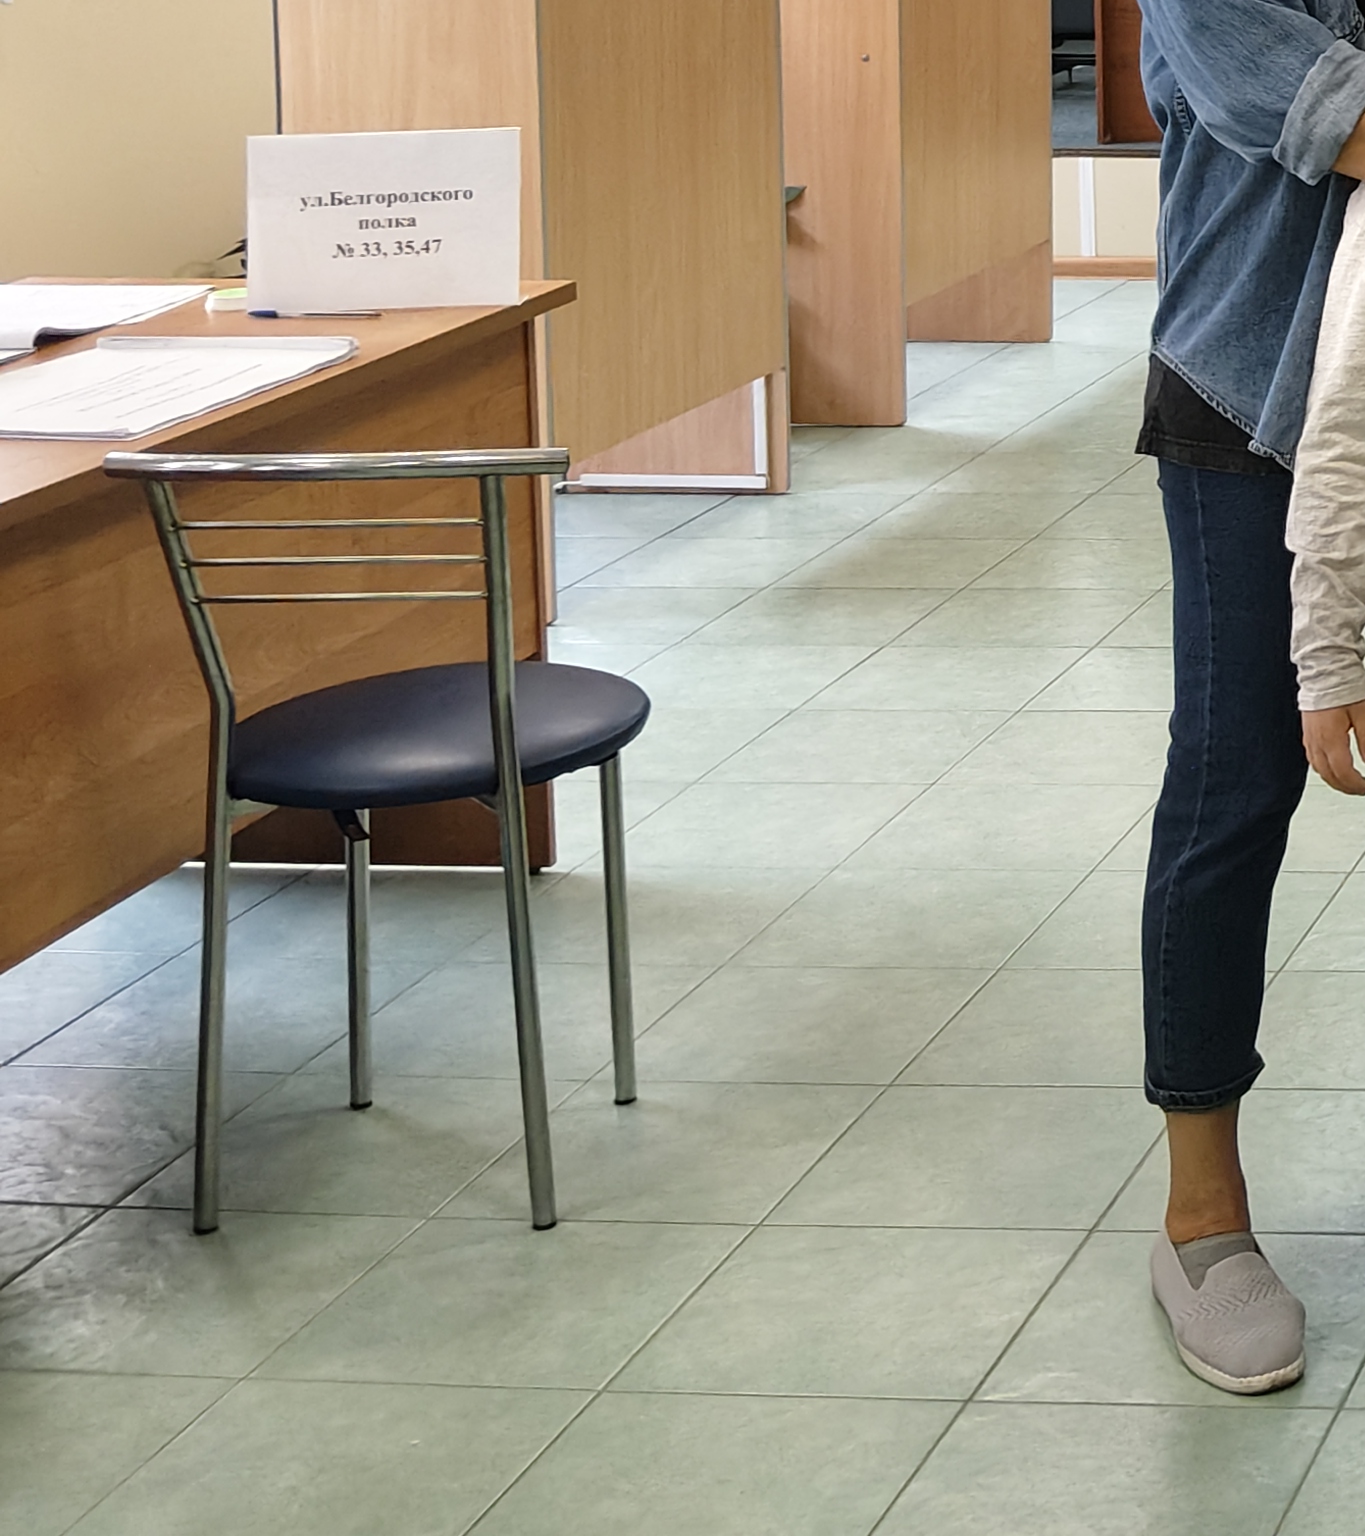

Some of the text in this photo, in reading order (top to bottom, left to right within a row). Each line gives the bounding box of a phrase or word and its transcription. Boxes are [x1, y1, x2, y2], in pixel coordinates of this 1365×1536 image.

[300, 188, 474, 212] ул.Белгородского
[358, 216, 417, 230] полка
[360, 241, 388, 259] 33,
